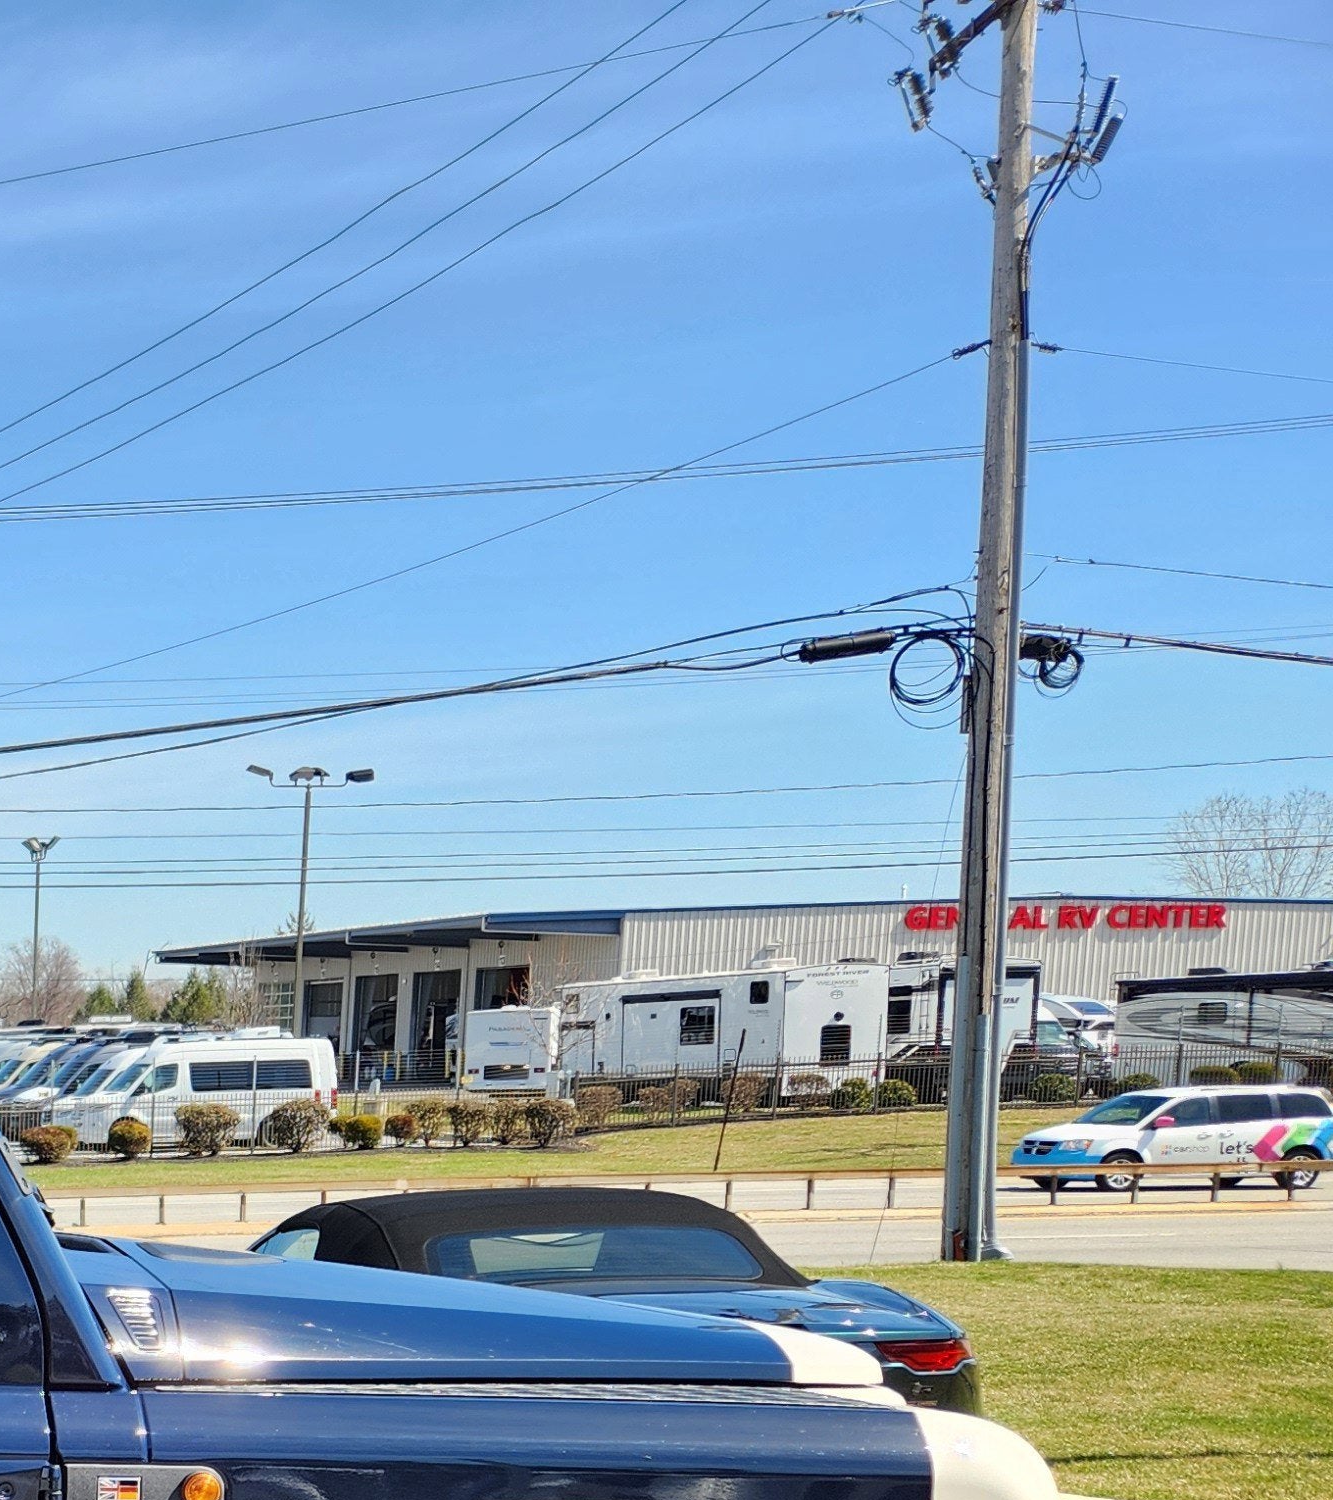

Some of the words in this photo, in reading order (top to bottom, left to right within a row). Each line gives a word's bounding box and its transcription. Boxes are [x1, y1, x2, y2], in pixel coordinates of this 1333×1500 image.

[904, 905, 1049, 931] GENAL
[1058, 905, 1101, 930] RV
[1106, 905, 1227, 930] CENTER
[1220, 1140, 1254, 1155] let's
